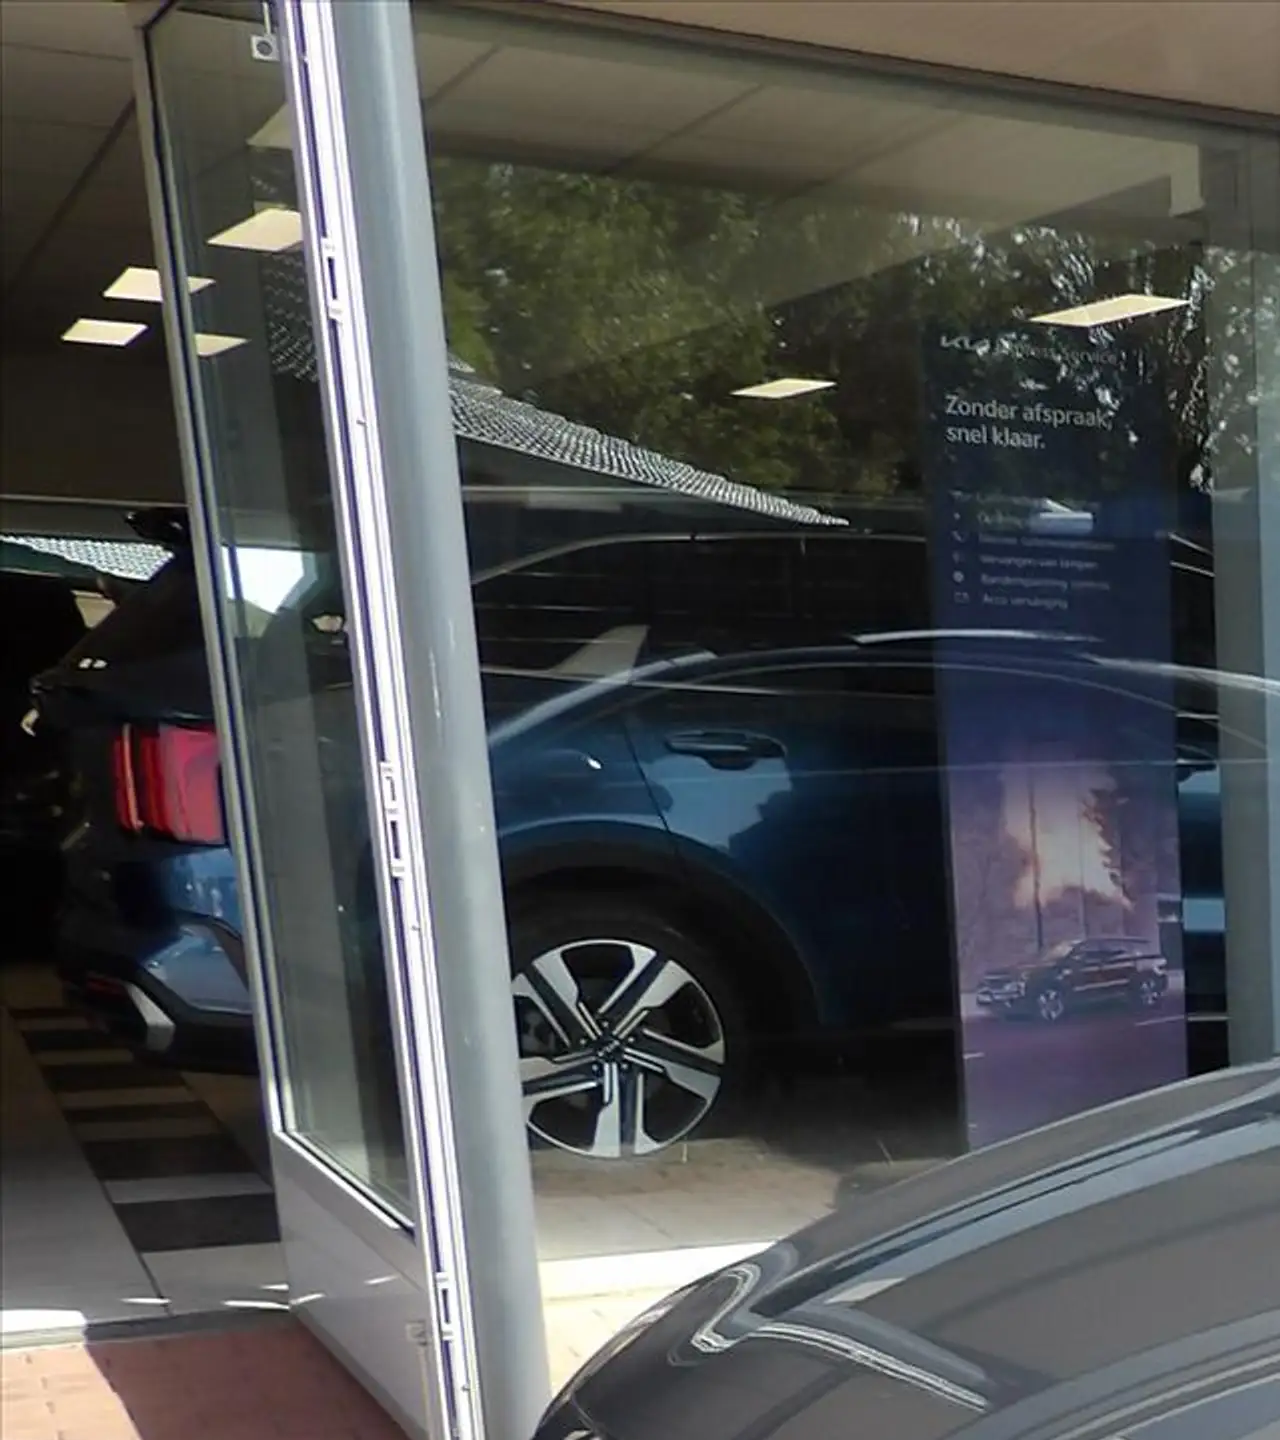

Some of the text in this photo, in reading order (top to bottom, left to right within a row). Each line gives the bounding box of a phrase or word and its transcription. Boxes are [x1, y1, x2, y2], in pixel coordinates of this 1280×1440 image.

[944, 394, 1114, 431] Zonder afspraak,
[944, 424, 1046, 450] snel klaar.
